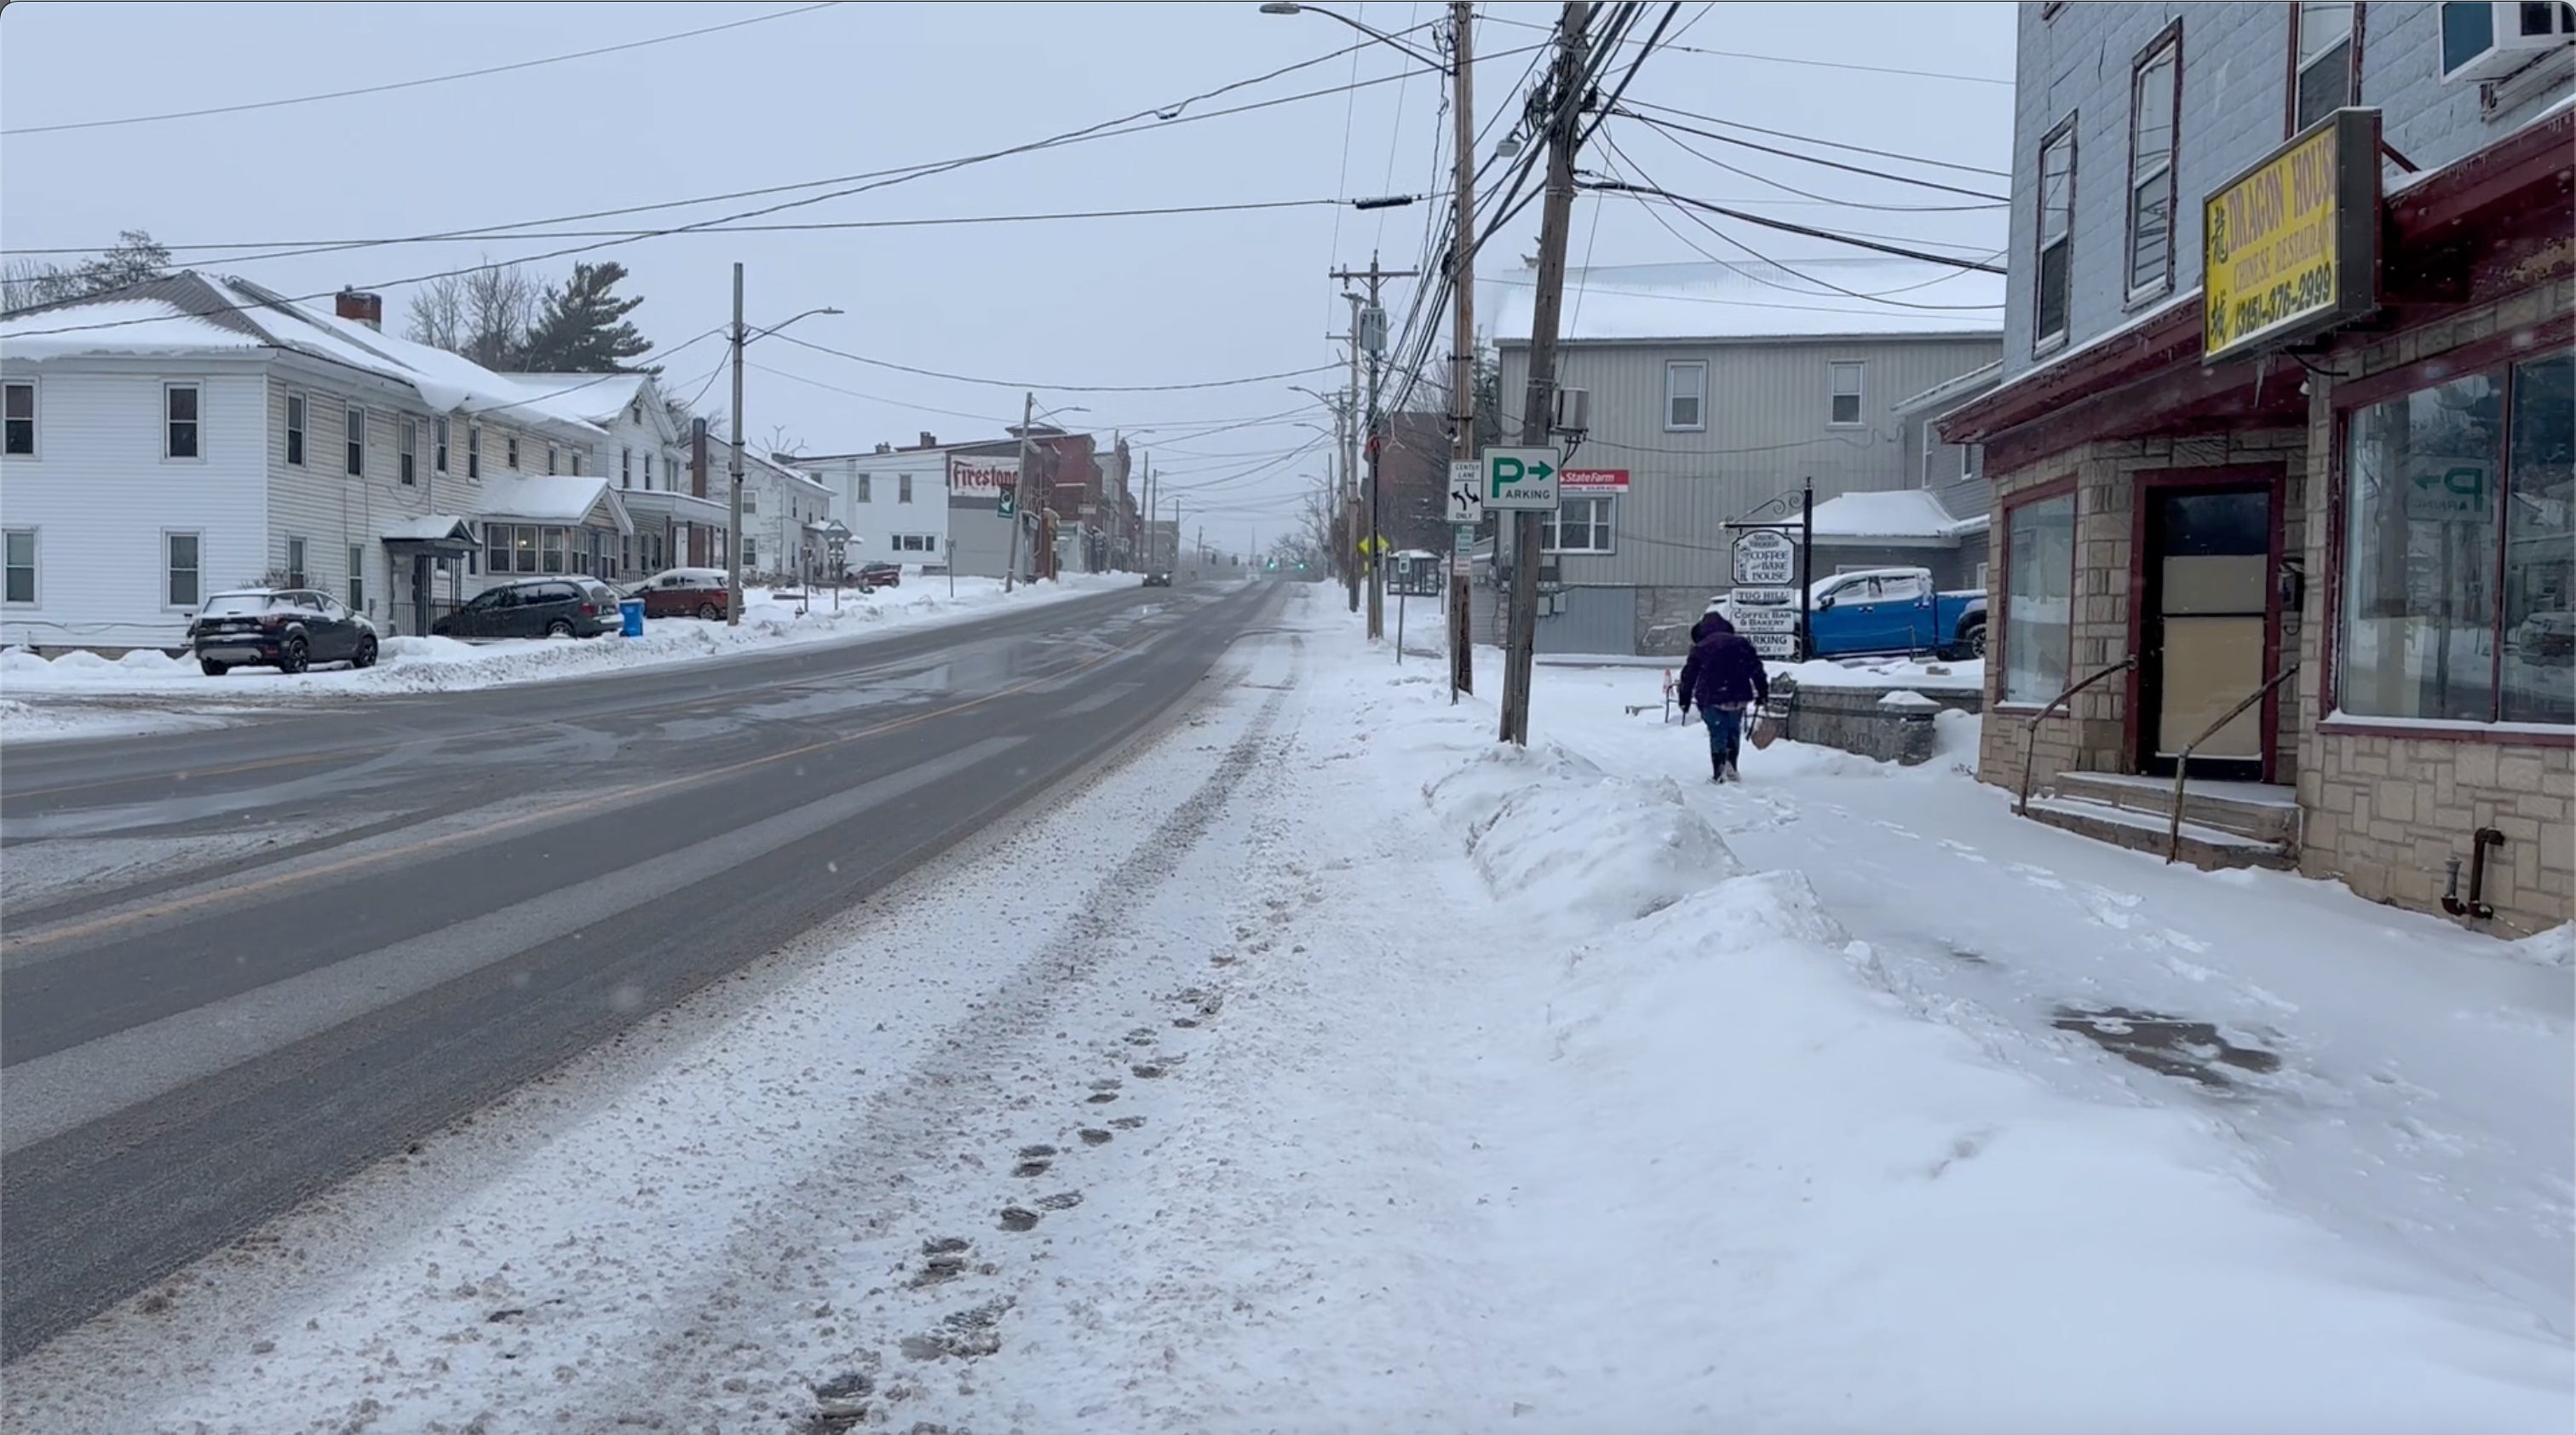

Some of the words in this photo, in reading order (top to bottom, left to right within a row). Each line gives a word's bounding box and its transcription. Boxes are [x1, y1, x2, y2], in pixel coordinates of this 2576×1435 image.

[2228, 164, 2284, 253] DRAGON
[2234, 245, 2270, 294] CHINESE
[952, 460, 1018, 490] Firestone
[1751, 550, 1788, 560] COFFEE
[1762, 562, 1787, 571] BAKE
[1752, 572, 1787, 581] HOUSE
[1739, 591, 1761, 600] TUG
[1763, 591, 1789, 600] HILL
[1746, 635, 1787, 645] ARKING
